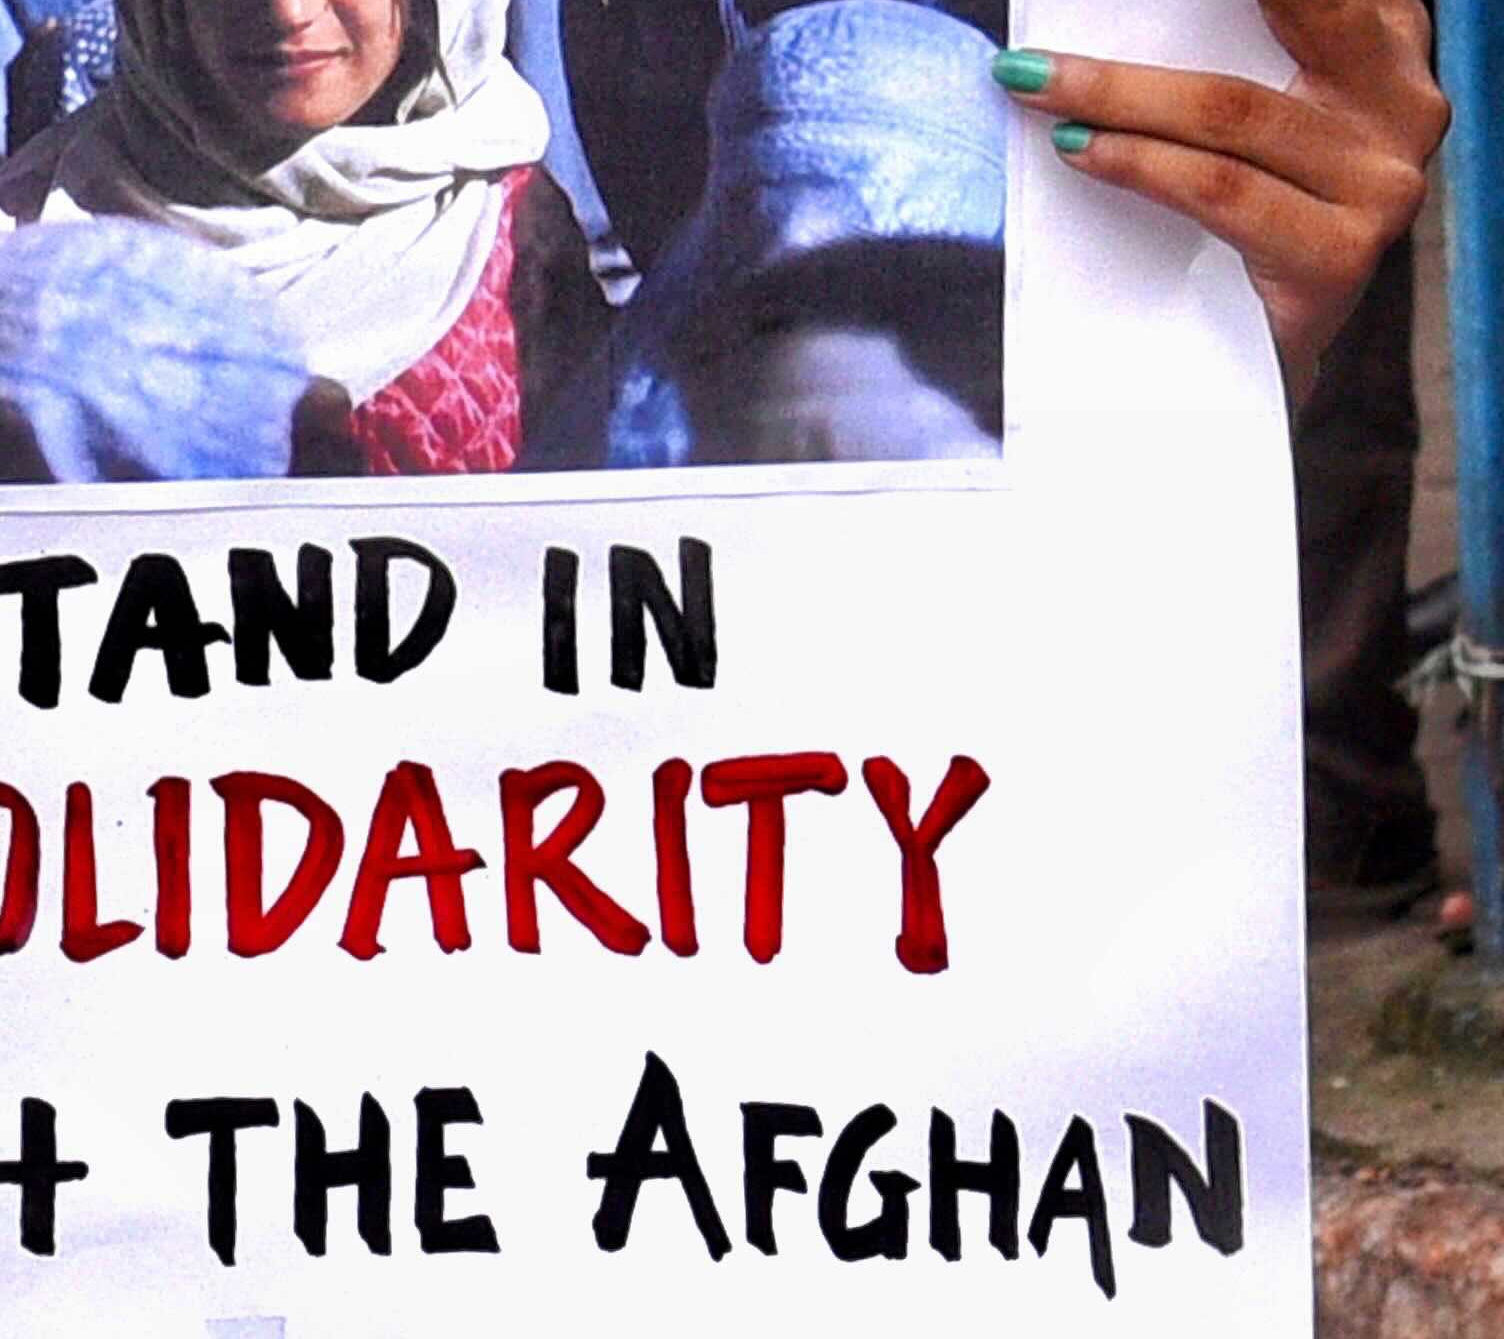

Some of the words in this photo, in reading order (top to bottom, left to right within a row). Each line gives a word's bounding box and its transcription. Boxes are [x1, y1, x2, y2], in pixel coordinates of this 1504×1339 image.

[543, 538, 717, 695] IN
[166, 1087, 499, 1266] THE
[587, 1051, 1242, 1299] AFGHAN
